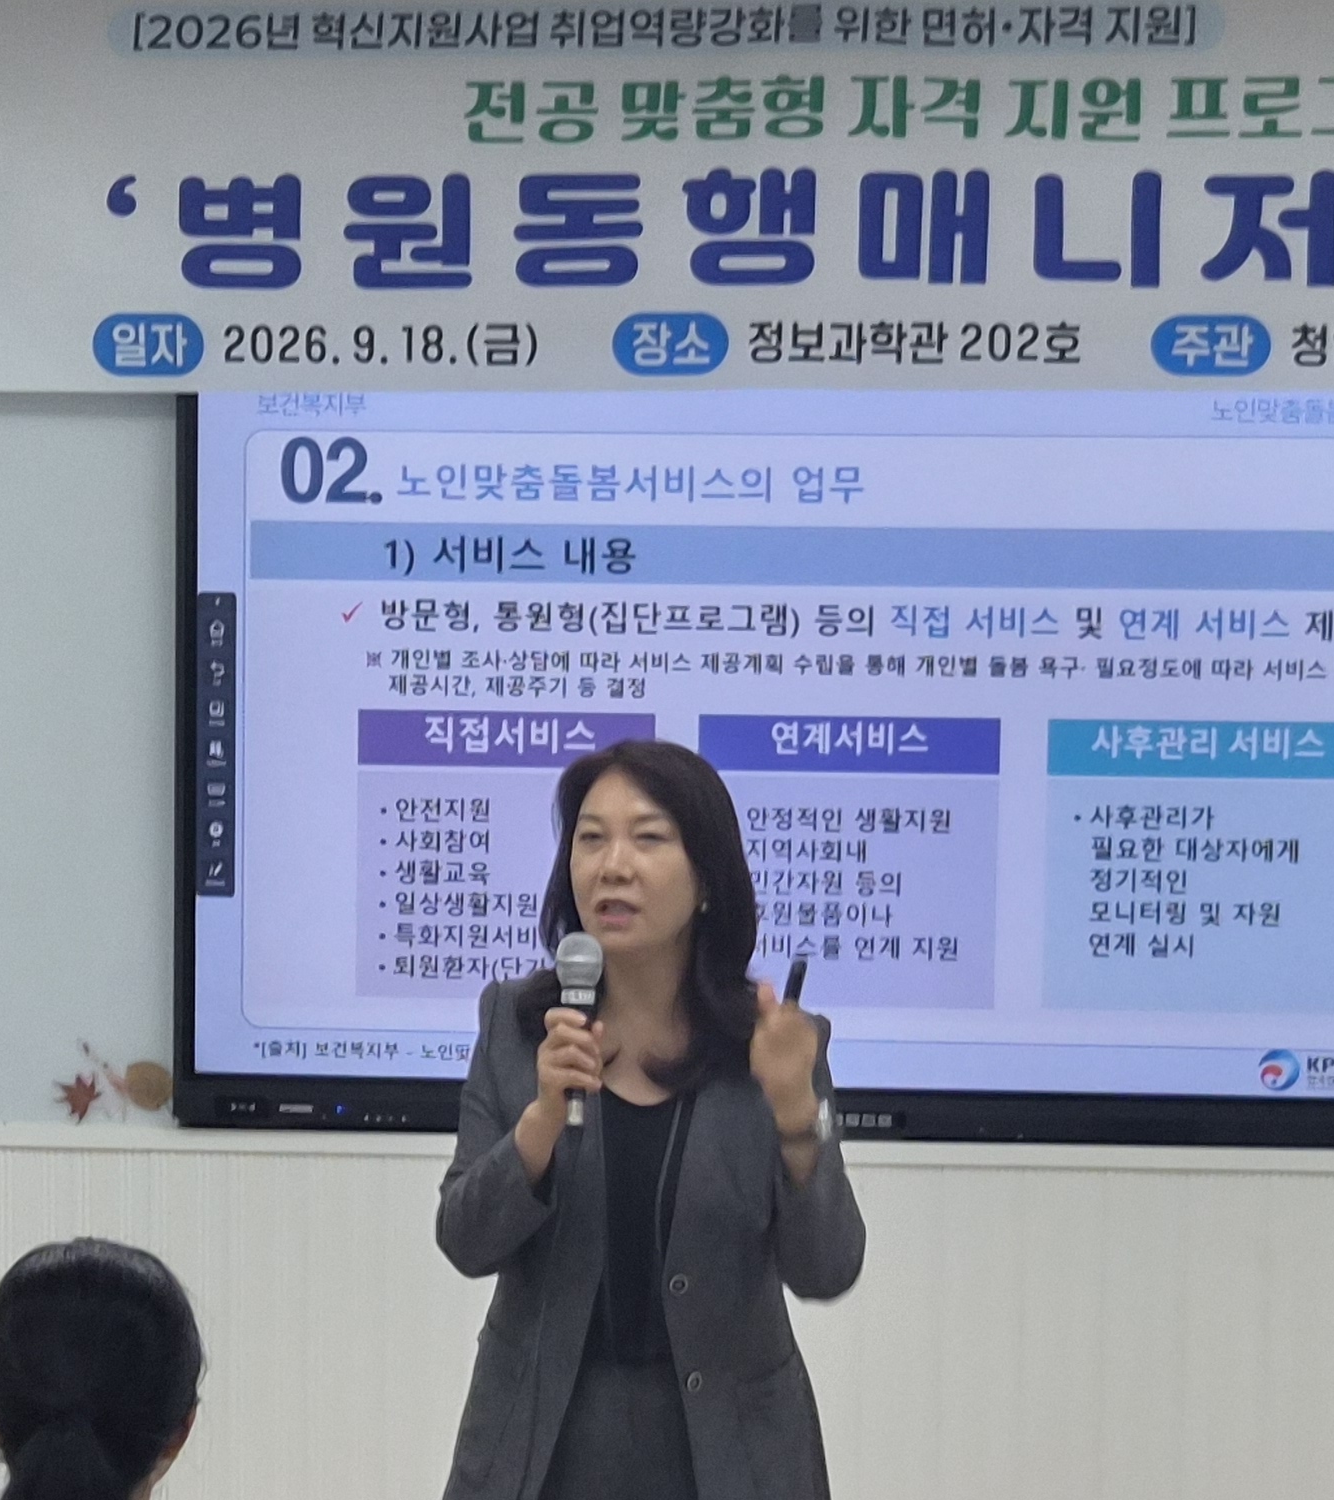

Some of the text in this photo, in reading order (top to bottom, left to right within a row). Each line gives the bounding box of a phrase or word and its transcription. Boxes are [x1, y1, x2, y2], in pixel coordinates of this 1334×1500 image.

[133, 13, 300, 51] [2026년
[313, 10, 540, 49] 혁신지원사업
[834, 5, 912, 46] 위한
[923, 4, 1094, 46] 면허·자격
[1105, 4, 1196, 46] 지원]
[464, 75, 599, 144] 전공
[621, 74, 826, 143] 맞춤형
[848, 74, 981, 139] 자격
[1006, 74, 1142, 141] 지원
[111, 322, 188, 368] 일자
[632, 322, 711, 368] 장소
[748, 321, 948, 366] 정보과학관
[959, 322, 1082, 366] 202호
[1171, 322, 1254, 368] 주관
[257, 392, 367, 417] 보건복지부
[281, 437, 865, 504] 02. 노인맞춤돌봄서비스의 업무
[384, 536, 637, 576] 1) 서비스 내용
[381, 598, 479, 633] 방문형,
[494, 600, 800, 639] 통원형(집단프로그램)
[815, 603, 875, 638] 등의
[890, 604, 950, 639] 직접
[966, 604, 1059, 639] 서비스
[1075, 606, 1102, 640] 및
[1119, 607, 1180, 641] 연계
[1195, 607, 1291, 641] 서비스
[391, 649, 452, 671] 개인별
[580, 651, 621, 673] 따라
[629, 652, 691, 674] 서비스
[700, 652, 784, 676] 제공계획
[794, 652, 855, 677] 수립을
[865, 653, 906, 677] 통해
[915, 654, 978, 678] 개인별
[989, 655, 1028, 678] 돌봄
[1096, 657, 1202, 681] 필요정도에
[1211, 658, 1255, 682] 따라
[1263, 659, 1327, 682] 서비스
[388, 674, 647, 699] 제공시간, 제공주기 등 결정
[424, 714, 596, 756] 직접서비스
[770, 720, 930, 755] 연계서비스
[1090, 725, 1326, 762] 사후관리 서비스
[395, 797, 491, 823] 안전지원
[746, 807, 951, 834] 안정적인 생활지원
[1089, 804, 1215, 831] 사후관리가
[394, 829, 491, 854] 사회참여
[746, 838, 867, 864] 지역사회내
[1091, 836, 1300, 864] 필요한 대상자에게
[394, 859, 491, 886] 생활교육
[855, 871, 902, 897] 등의
[1089, 867, 1188, 895] 정기적인
[394, 891, 538, 918] 일상생활지원
[1089, 900, 1281, 928] 모니터링 및 자원
[854, 935, 901, 961] 연계
[911, 936, 959, 962] 지원
[1088, 932, 1195, 959] 연계 실시
[315, 1040, 400, 1061] 보건복지부
